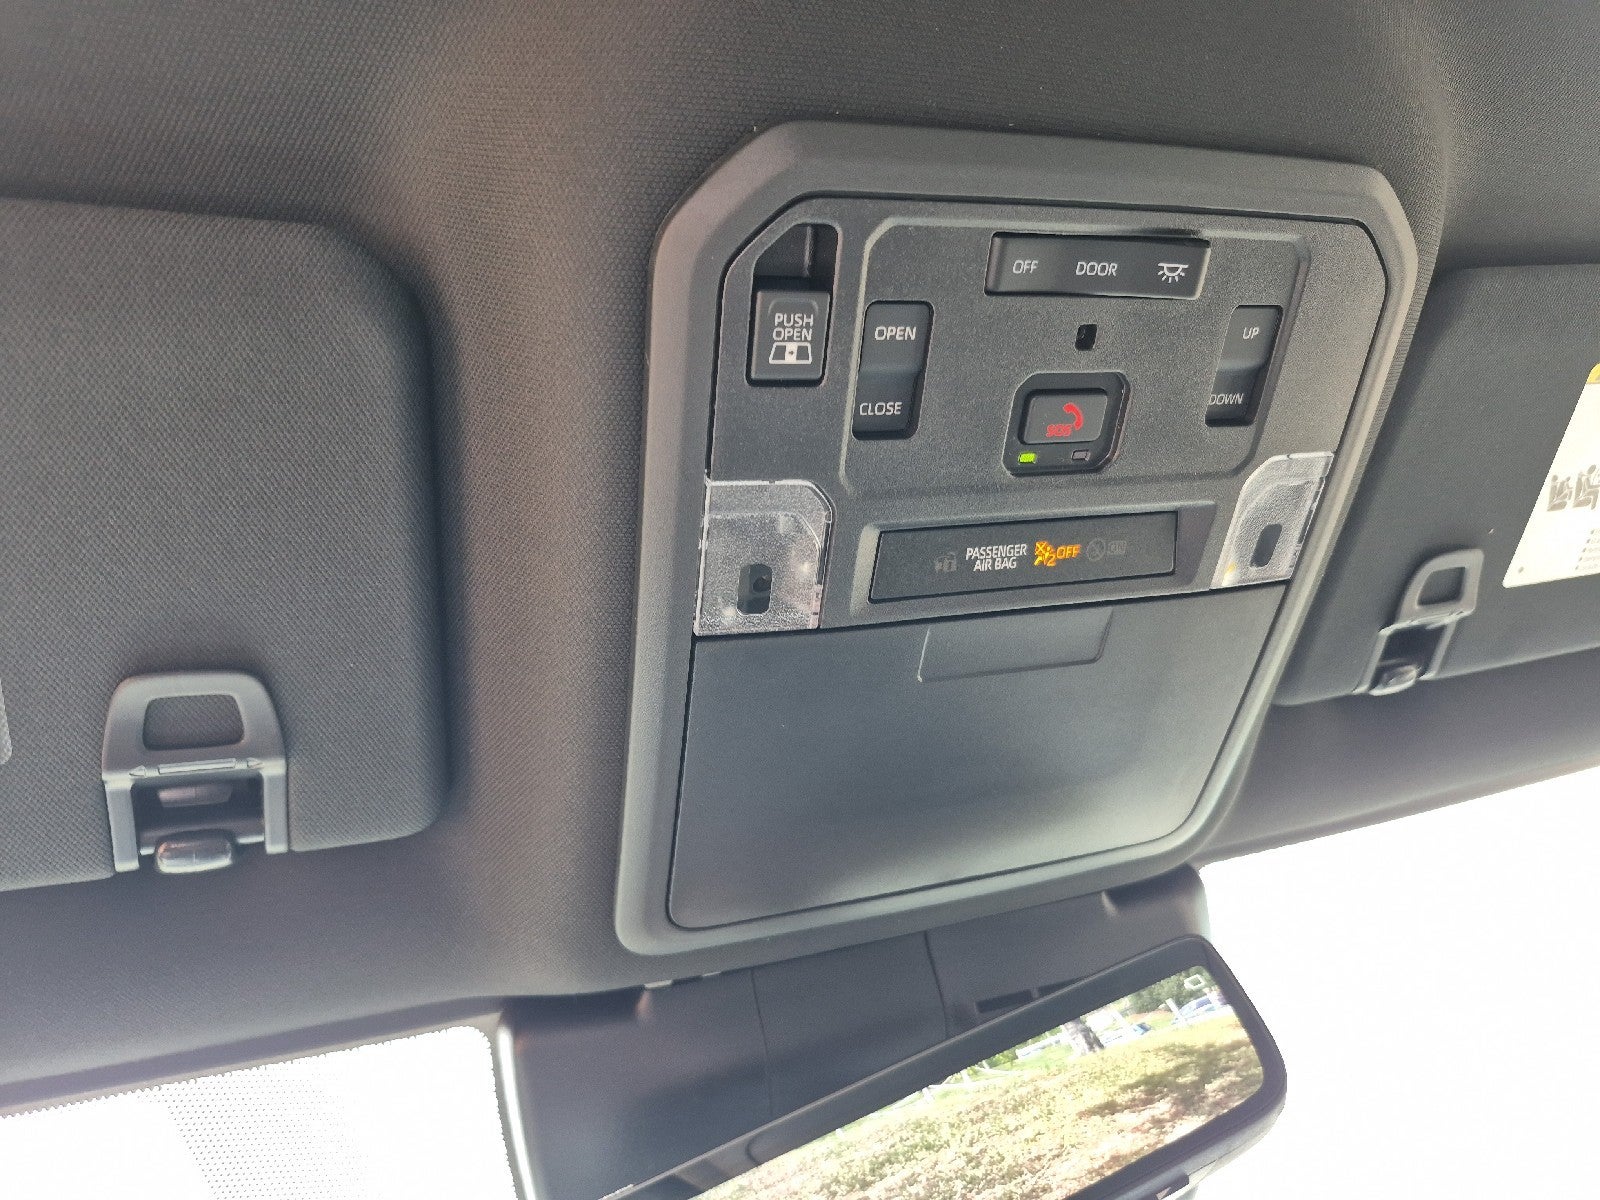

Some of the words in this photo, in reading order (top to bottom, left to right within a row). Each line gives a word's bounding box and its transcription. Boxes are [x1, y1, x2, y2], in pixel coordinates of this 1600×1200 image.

[1012, 260, 1038, 274] OFF
[1076, 261, 1118, 276] DOOR
[774, 313, 814, 327] PUSH
[772, 327, 812, 341] OPEN
[874, 326, 917, 341] OPEN
[1242, 327, 1260, 339] UP
[1208, 393, 1243, 405] DOWN
[859, 402, 902, 416] CLOSE
[1046, 424, 1072, 438] SOS
[966, 544, 1027, 561] PASSENGER
[973, 559, 992, 572] AIR
[994, 557, 1017, 570] BAG
